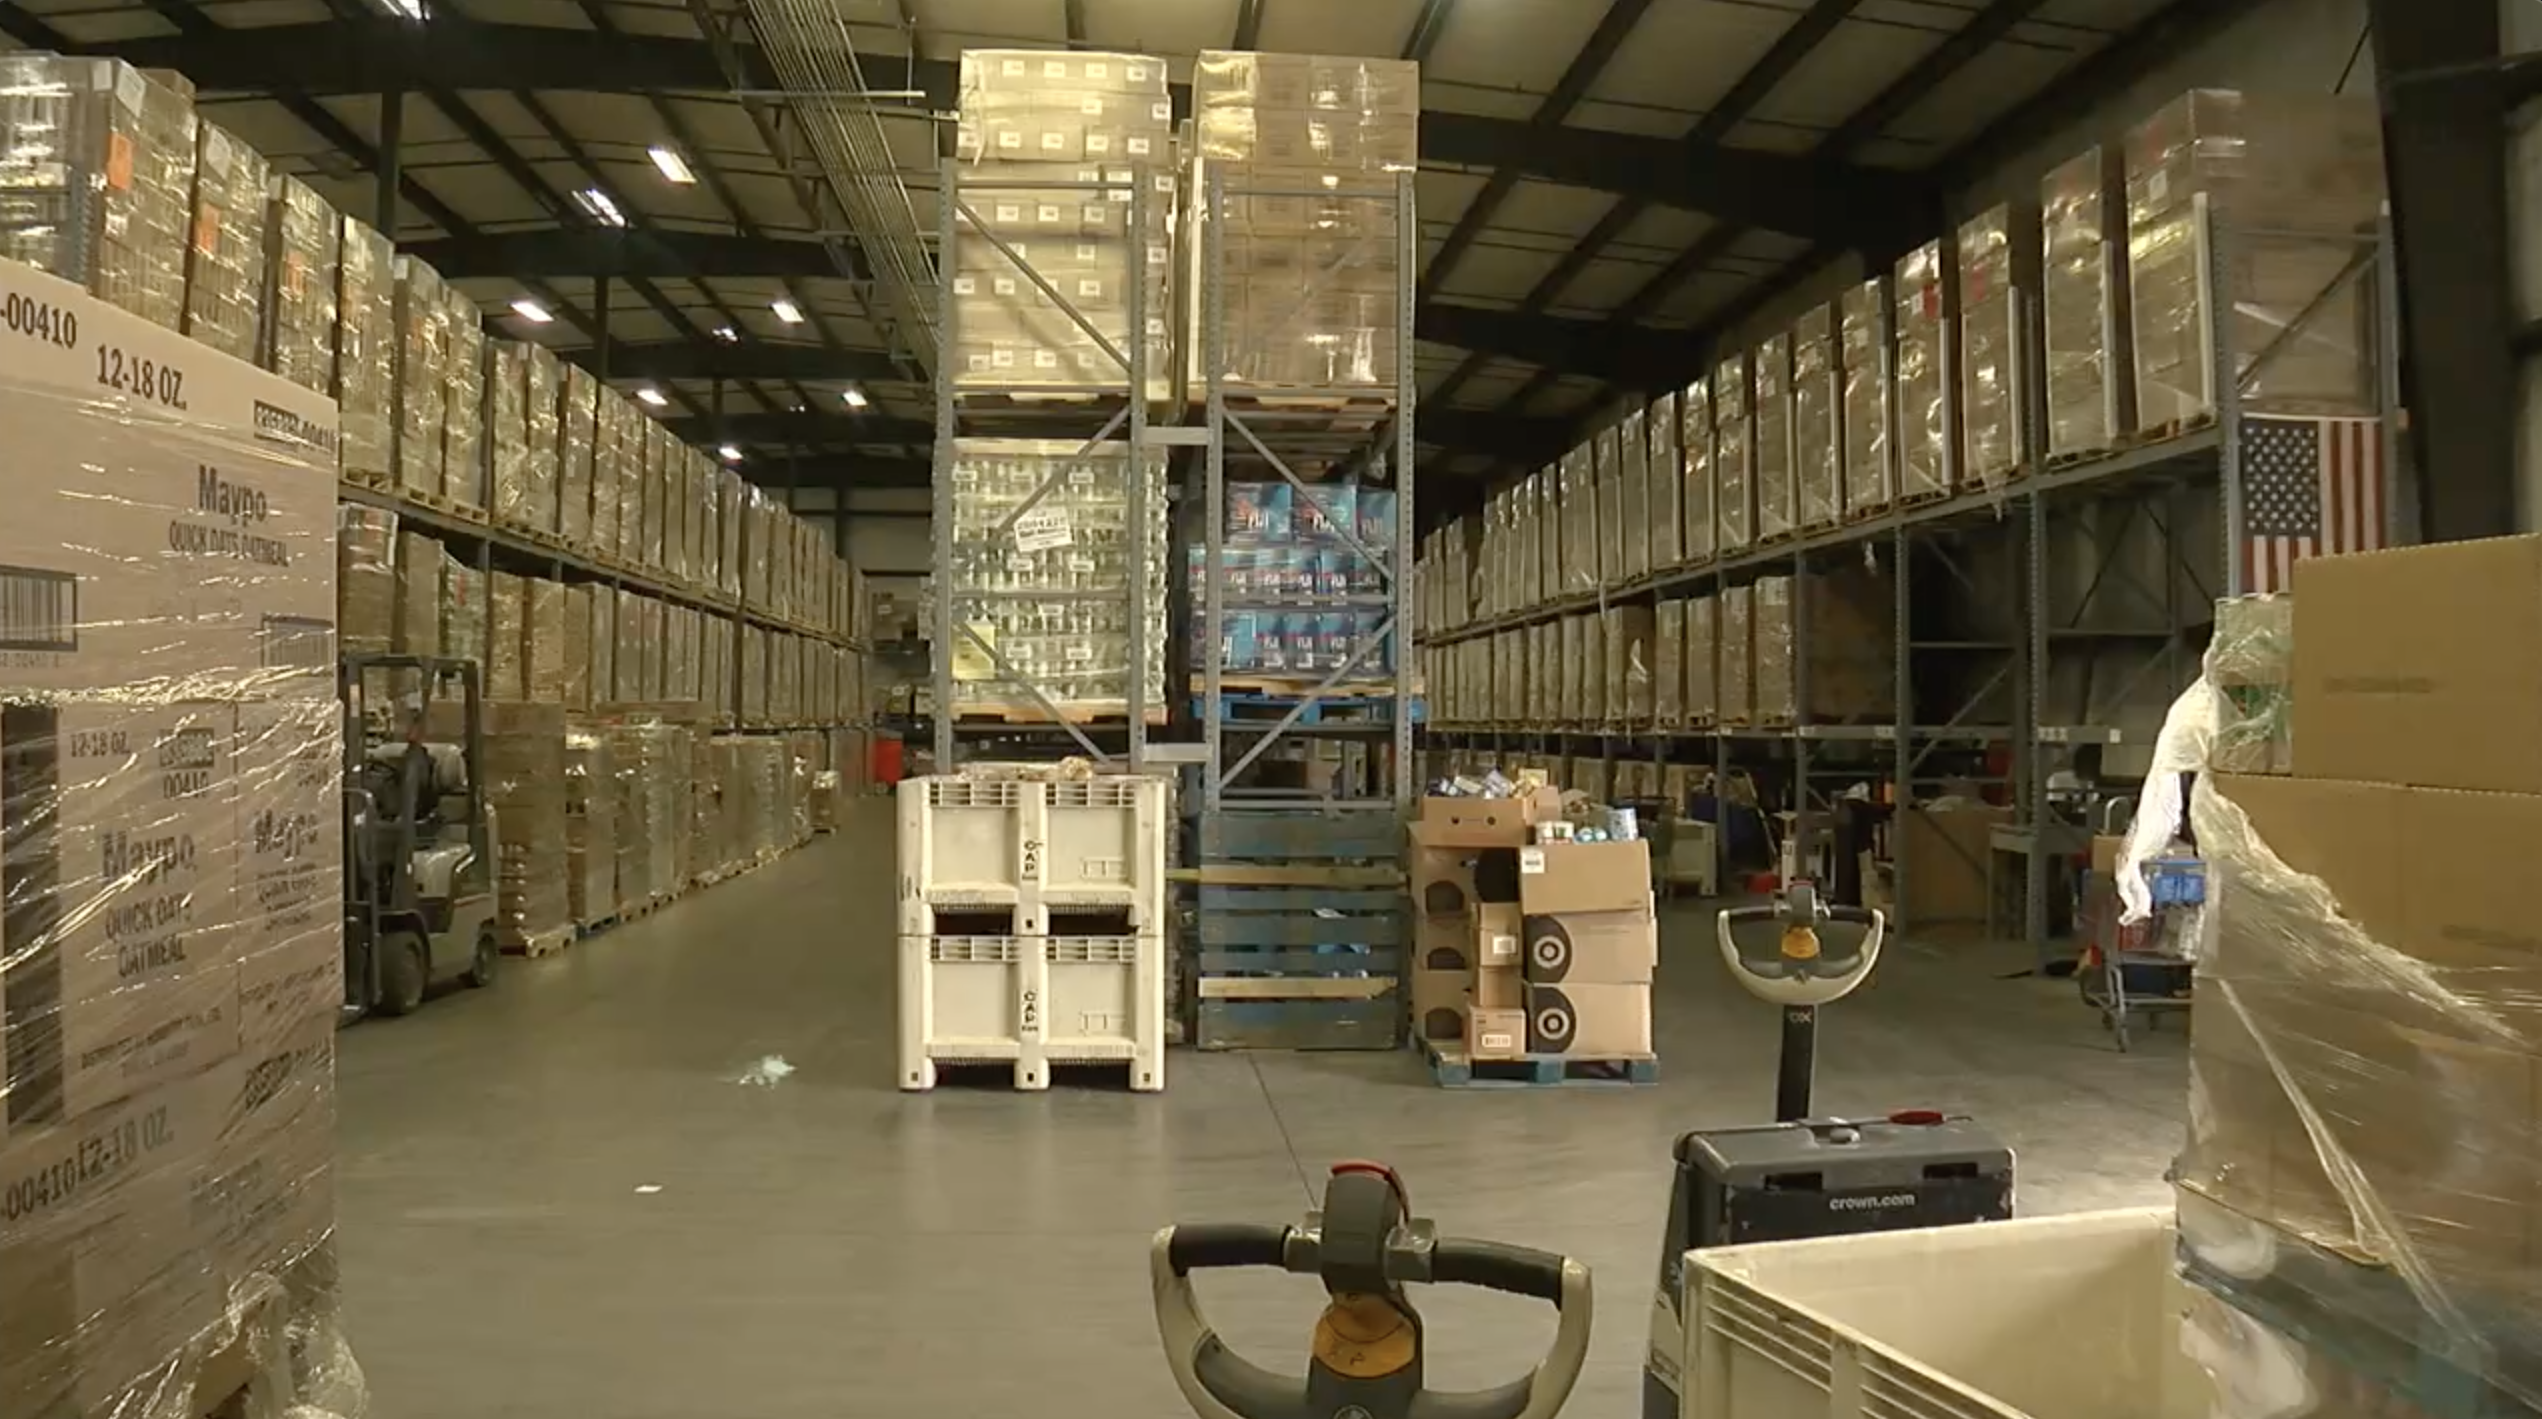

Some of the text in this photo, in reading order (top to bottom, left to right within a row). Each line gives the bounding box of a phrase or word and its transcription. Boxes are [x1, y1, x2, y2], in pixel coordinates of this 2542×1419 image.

[97, 344, 155, 399] 12-18
[198, 464, 267, 527] Maypo
[1829, 1194, 1915, 1210] crown.com
